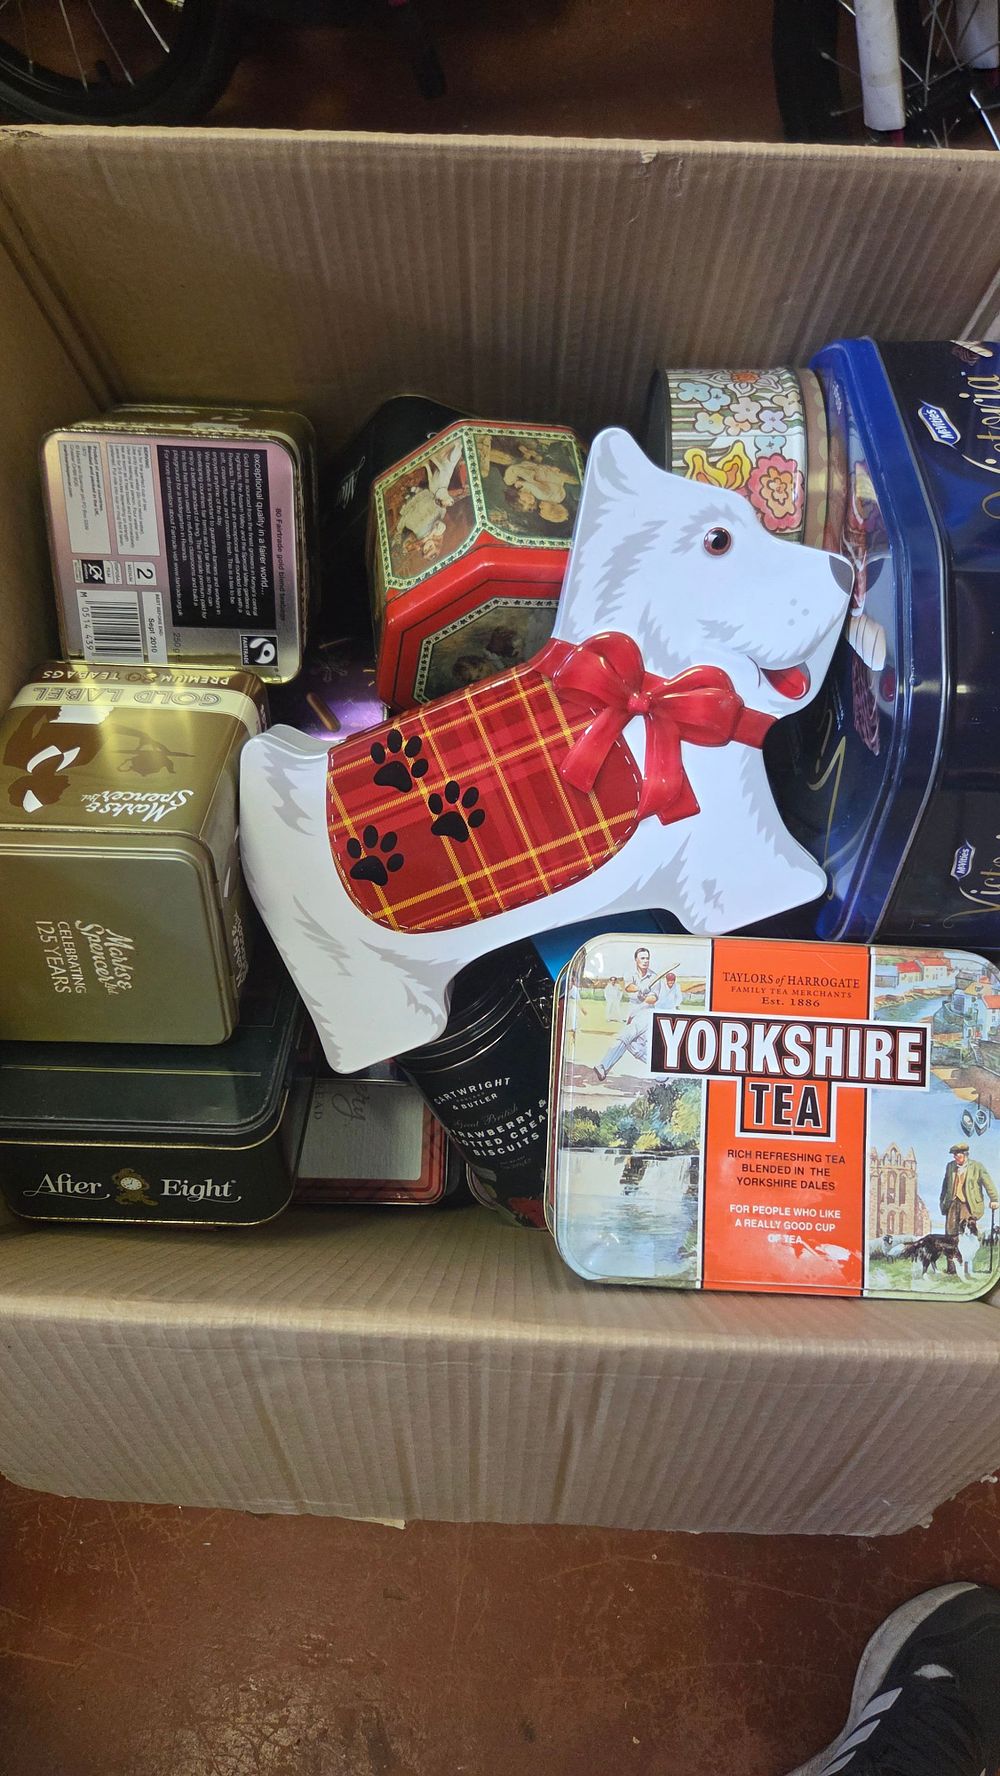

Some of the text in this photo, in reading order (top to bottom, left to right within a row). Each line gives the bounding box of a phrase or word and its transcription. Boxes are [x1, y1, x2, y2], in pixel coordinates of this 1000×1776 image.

[252, 453, 264, 499] exceptional
[254, 501, 265, 527] quality
[275, 518, 283, 552] Fairtrade
[136, 567, 153, 579] 2
[81, 607, 90, 628] 0514
[147, 618, 155, 634] Sept
[84, 634, 93, 650] 439
[42, 670, 120, 681] TEABAGS
[161, 674, 230, 685] PREMIUM
[33, 687, 221, 706] GOLD LABEL
[101, 789, 194, 807] Spencer
[99, 802, 177, 822] Marks
[35, 920, 72, 994] 125 YEARS
[57, 921, 87, 994] CELEBRATING
[74, 920, 114, 983] Spencer
[104, 928, 136, 981] Marks
[722, 971, 860, 990] TAYLORS of HARROGATE
[730, 985, 853, 999] FAMILY TEA MERCHANTS
[761, 996, 820, 1008] Est. 1886
[657, 1018, 923, 1082] YORKSHIRE
[433, 1077, 511, 1105] CARTWRIGHT
[461, 1093, 498, 1110] BUTLER
[749, 1082, 823, 1129] TEA
[450, 1099, 547, 1139] TRAWBERRY &
[510, 1108, 549, 1139] CREA
[472, 1132, 540, 1157] BISCUITS
[727, 1149, 846, 1165] RICH REFRESHING TEA
[741, 1164, 831, 1177] BLENDED IN THE
[23, 1172, 241, 1203] After Eight
[736, 1177, 836, 1191] YORKSHIRE DALES
[729, 1204, 841, 1219] FOR PEOPLE WHO LIKE
[734, 1219, 836, 1232] A REALLY GOOD CUP
[767, 1234, 803, 1244] OF TEA
